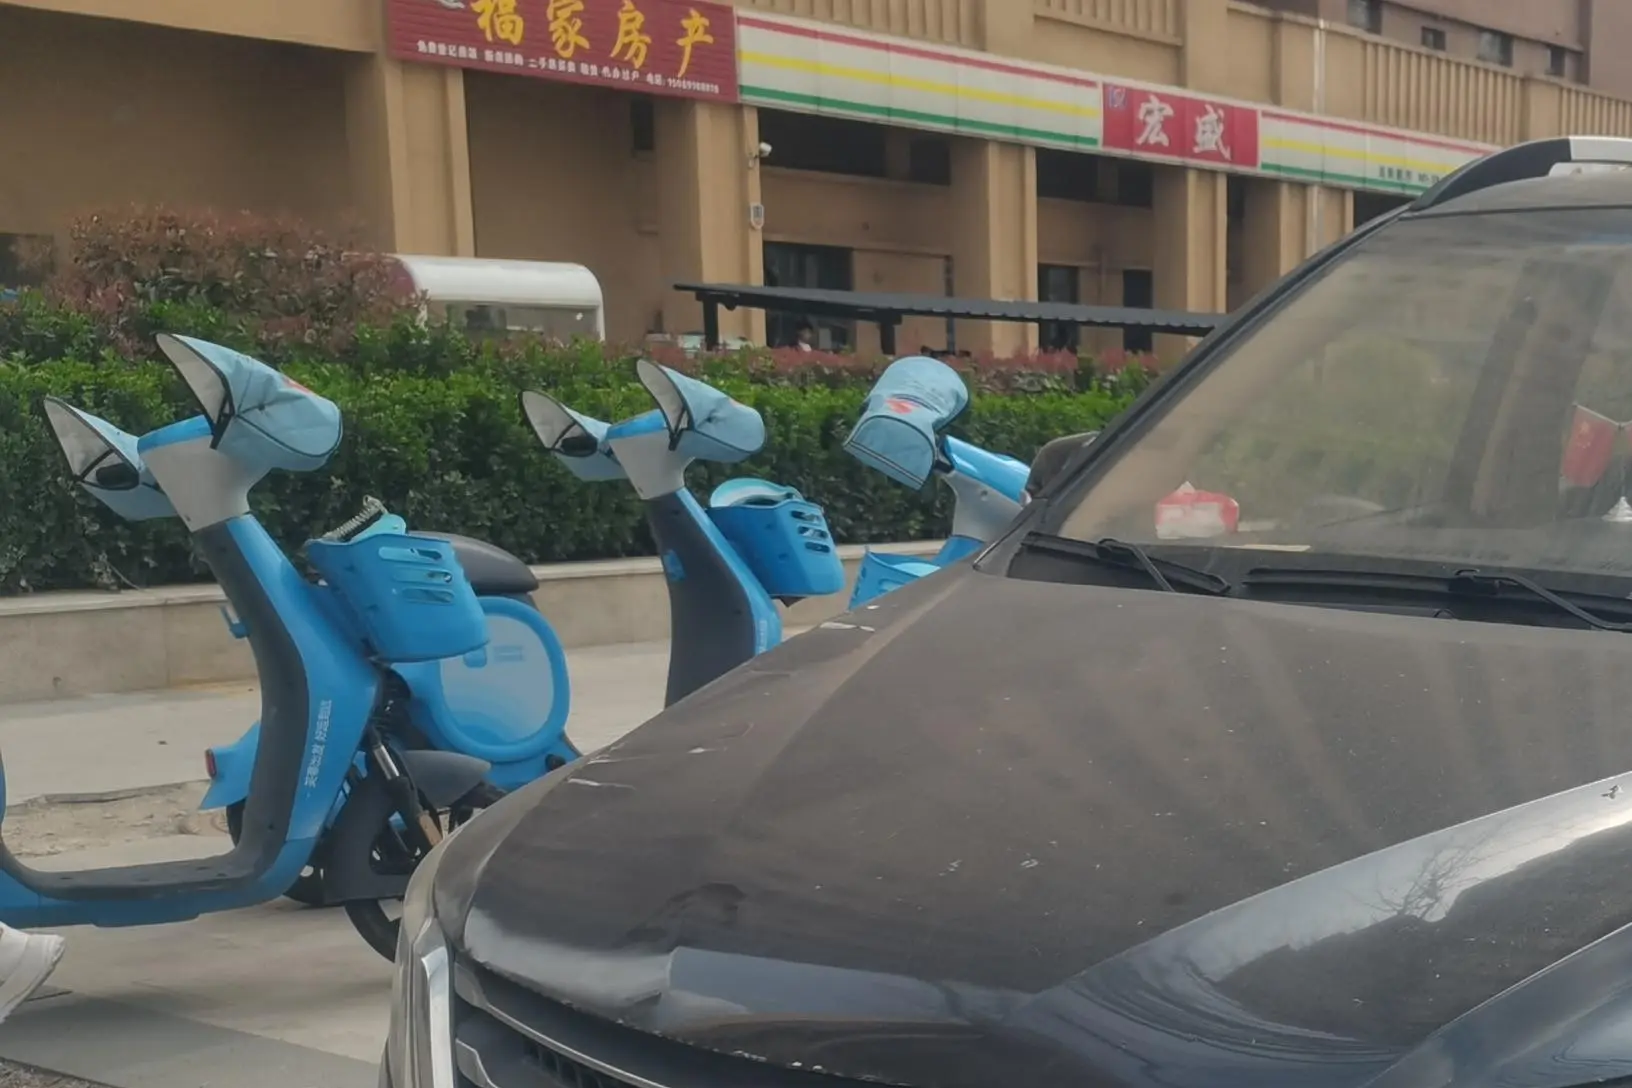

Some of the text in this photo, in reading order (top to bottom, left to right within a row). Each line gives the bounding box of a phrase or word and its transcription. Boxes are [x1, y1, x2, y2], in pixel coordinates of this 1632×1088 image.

[470, 0, 715, 77] 福家房产
[1136, 94, 1232, 162] 宏盛
